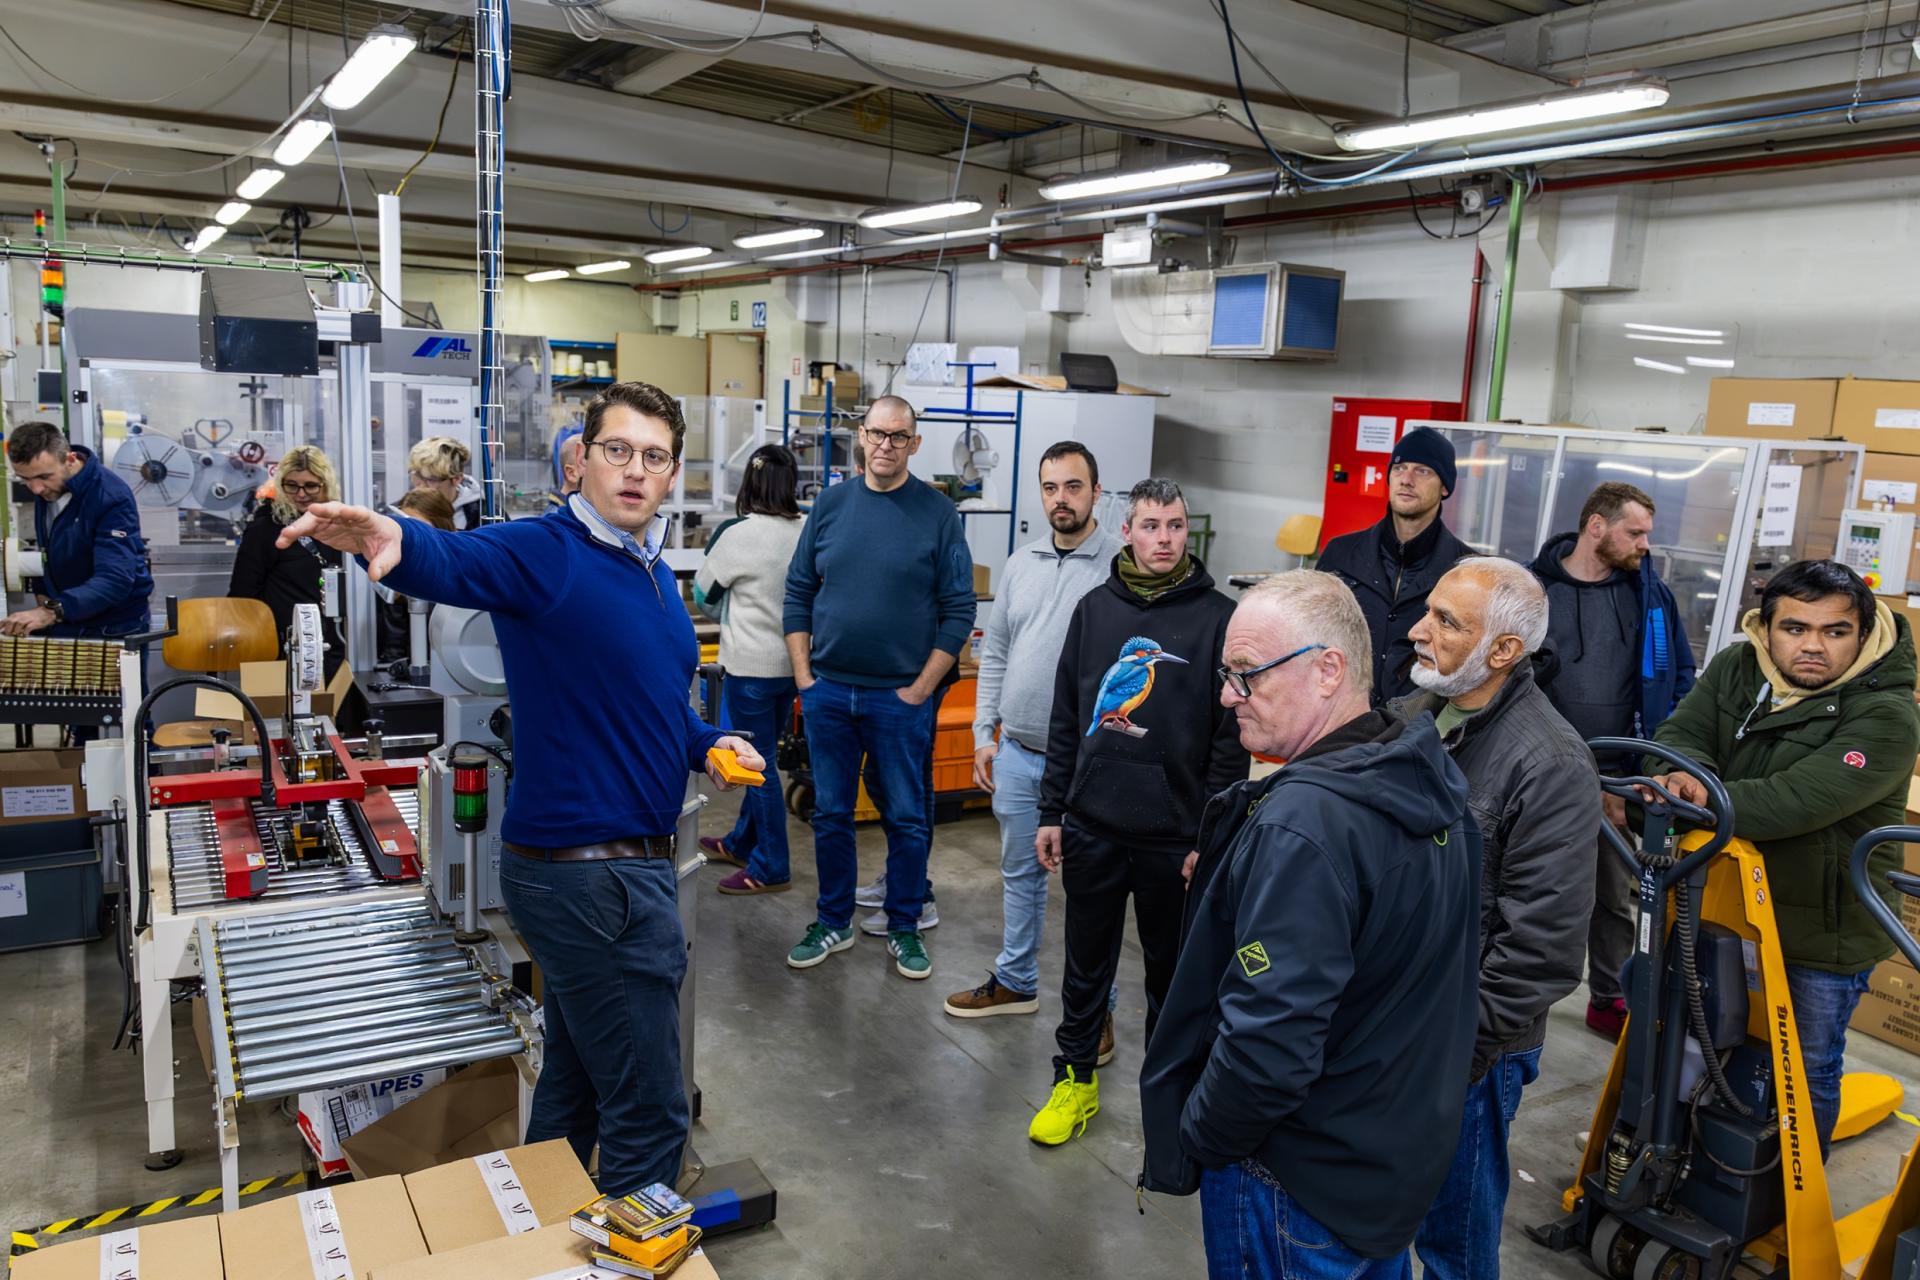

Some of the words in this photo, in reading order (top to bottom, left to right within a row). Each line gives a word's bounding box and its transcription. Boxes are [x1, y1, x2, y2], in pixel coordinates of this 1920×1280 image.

[753, 303, 766, 326] 02
[442, 352, 471, 361] TECH
[1776, 1005, 1804, 1192] JUNGHEINRICH
